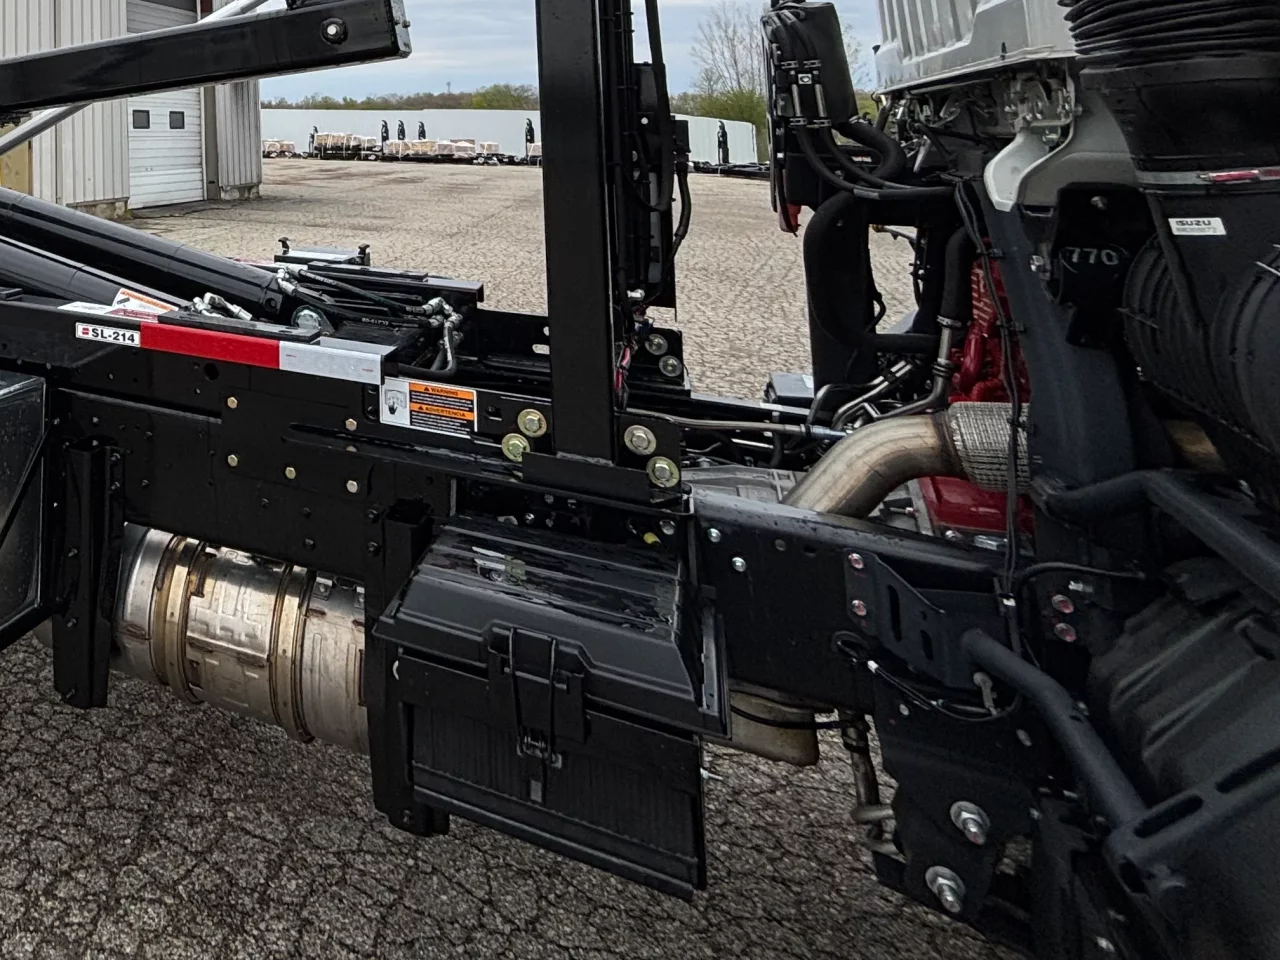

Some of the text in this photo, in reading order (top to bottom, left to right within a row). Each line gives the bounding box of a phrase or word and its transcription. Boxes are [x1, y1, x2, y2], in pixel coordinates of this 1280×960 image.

[91, 327, 135, 343] SL-214
[430, 387, 459, 396] WARNING
[425, 406, 467, 417] ADVERTENCIA
